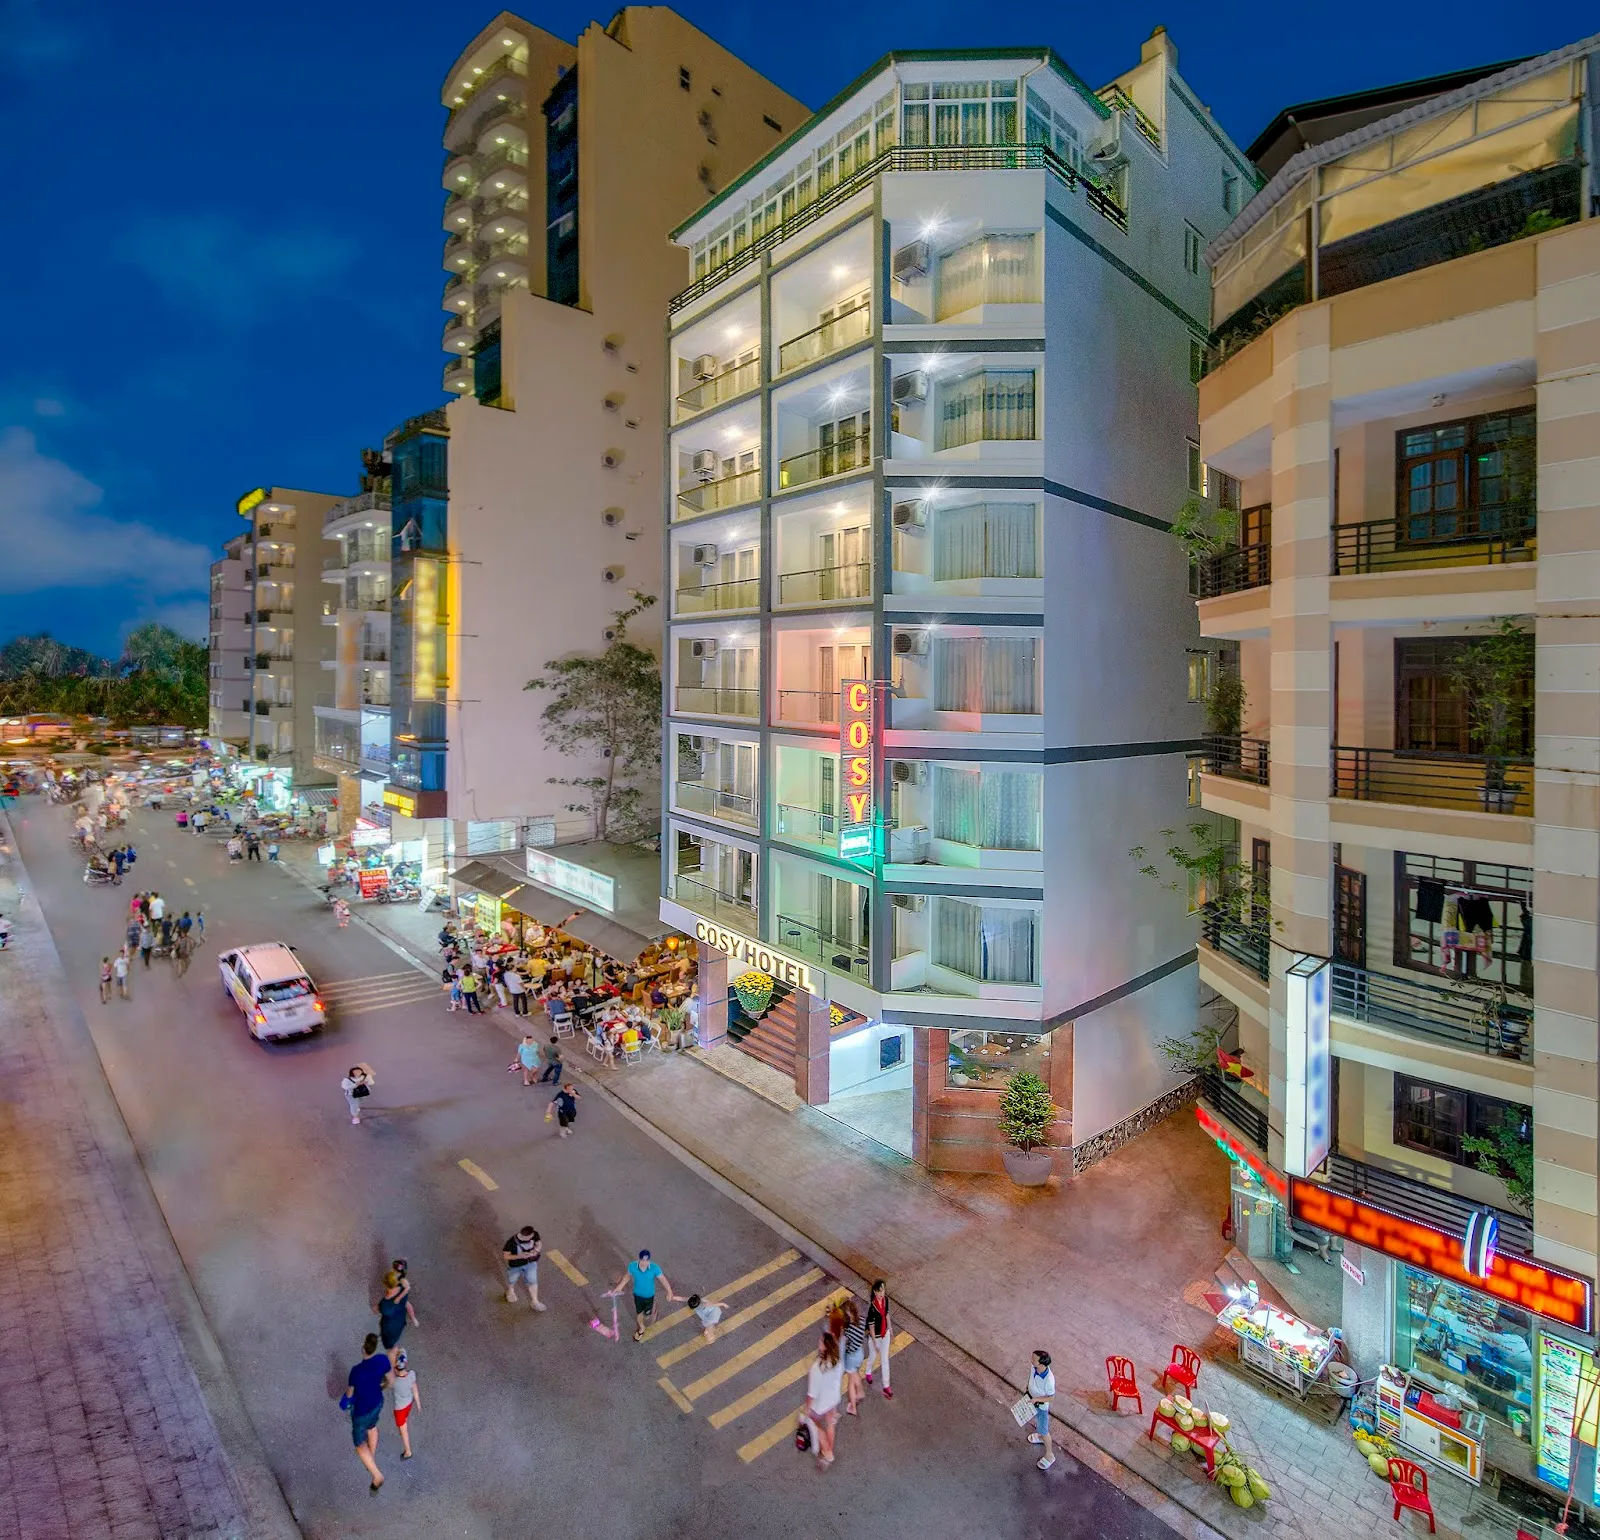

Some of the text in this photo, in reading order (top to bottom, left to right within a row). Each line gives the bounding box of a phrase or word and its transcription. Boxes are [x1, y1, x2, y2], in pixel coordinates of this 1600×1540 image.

[849, 683, 869, 823] COSY
[696, 922, 810, 992] COSY HOTEL
[1544, 1338, 1577, 1357] Ken
